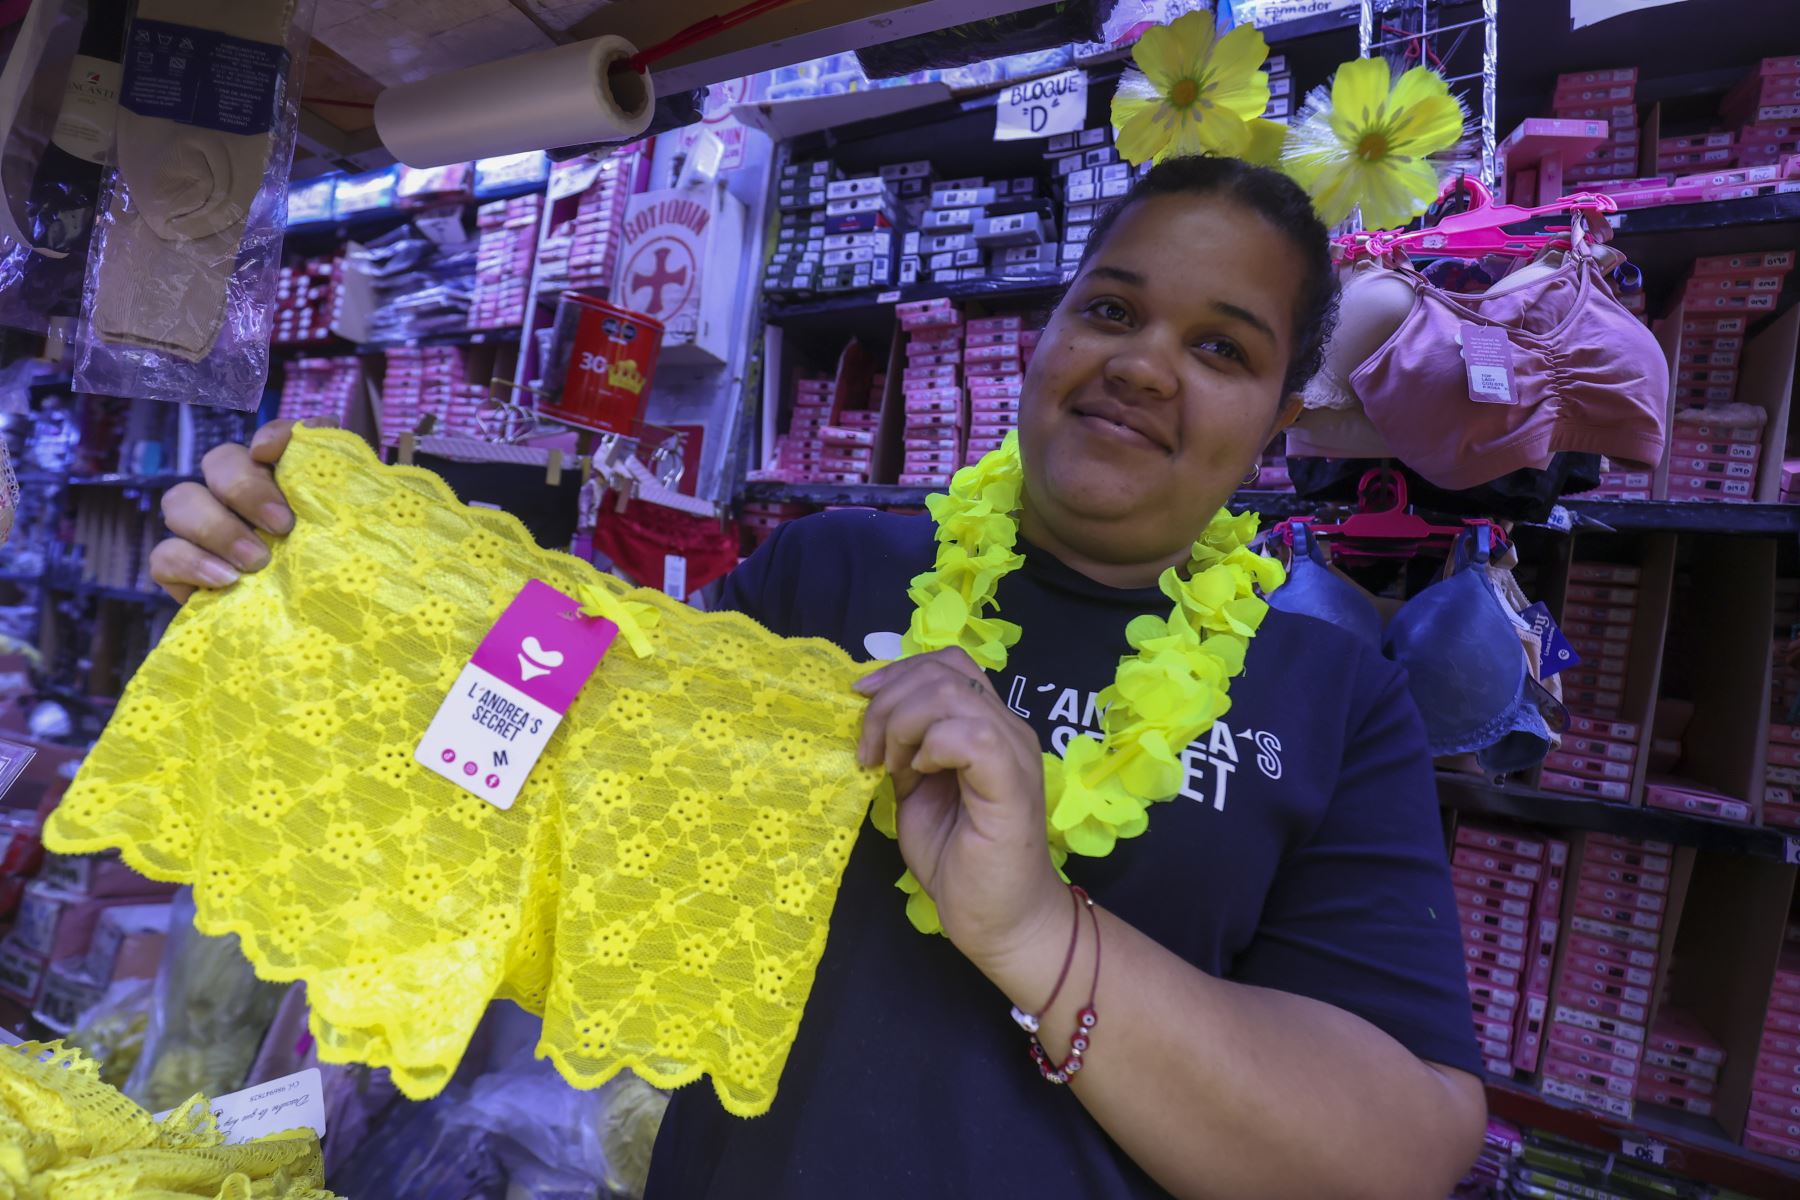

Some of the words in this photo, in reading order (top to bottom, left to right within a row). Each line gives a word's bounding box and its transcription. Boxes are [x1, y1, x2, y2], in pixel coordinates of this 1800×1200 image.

[1011, 74, 1081, 106] BLOQUE
[622, 199, 711, 246] BOTIQUIN
[472, 705, 522, 742] SECRET
[493, 750, 509, 768] M
